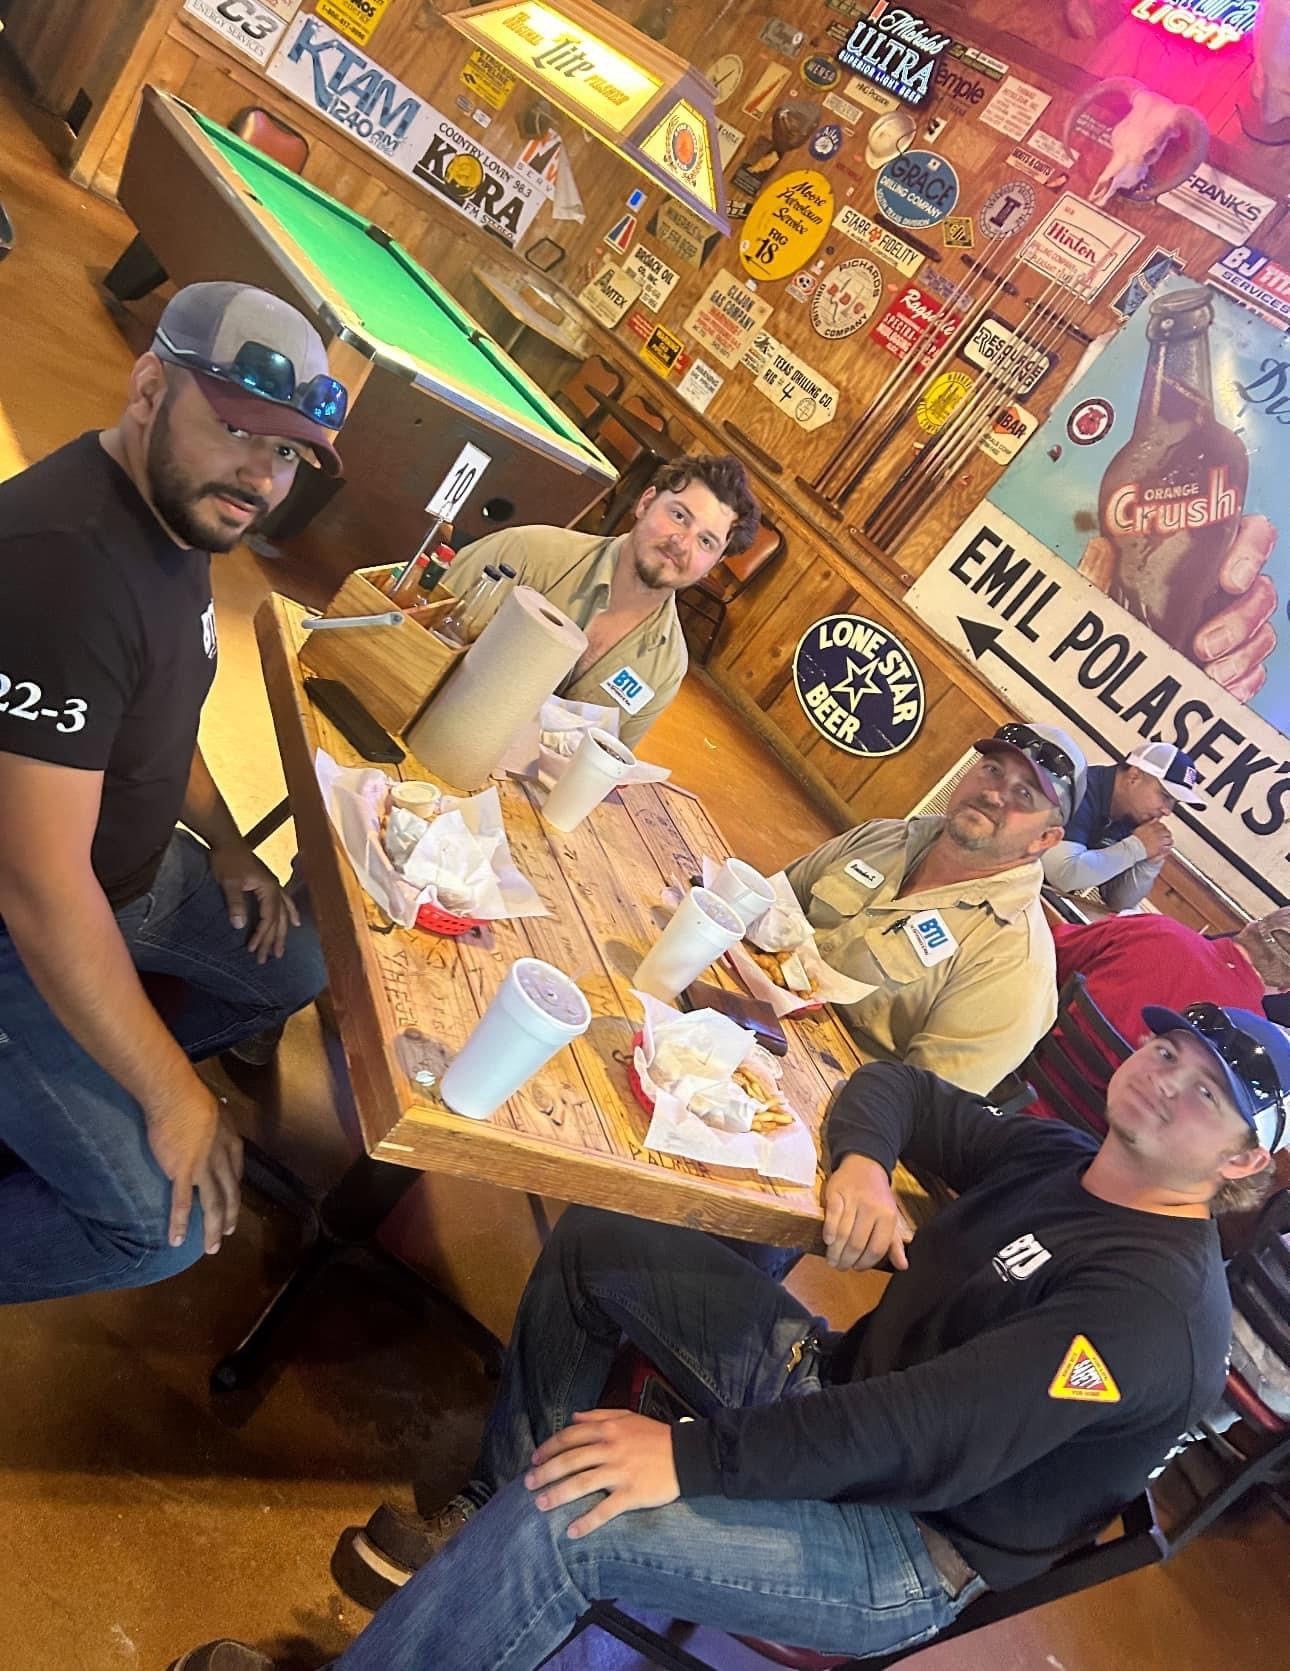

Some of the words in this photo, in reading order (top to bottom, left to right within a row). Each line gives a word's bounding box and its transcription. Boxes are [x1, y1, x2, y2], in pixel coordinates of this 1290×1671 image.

[226, 22, 267, 58] SERVICES
[878, 9, 951, 55] Michelob
[1131, 0, 1242, 50] LIGHT
[530, 32, 596, 78] Lite
[846, 21, 935, 96] ULTRA
[288, 18, 421, 139] KTAM
[838, 49, 876, 80] SUPERIOR
[875, 69, 901, 93] LIGHT
[898, 83, 923, 105] BEER
[327, 96, 375, 139] 1240
[439, 122, 484, 160] COUNTRY
[462, 201, 481, 221] FM
[777, 188, 824, 225] Petroleum
[788, 181, 828, 208] Moore
[879, 175, 907, 197] DRILLING
[907, 191, 944, 218] COMPANY
[754, 237, 780, 265] 18
[768, 227, 789, 246] RIG
[841, 210, 869, 235] STARR
[879, 233, 918, 266] FIDELITY
[1046, 221, 1096, 264] Hinton
[634, 248, 663, 274] BROACH
[660, 264, 675, 286] OIL
[838, 258, 882, 298] RICHARDS
[1222, 246, 1268, 278] BJ
[709, 289, 724, 308] GAS
[722, 299, 757, 332] COMPANY
[811, 283, 827, 328] DRILLING
[1220, 270, 1290, 317] SERVICES
[823, 312, 868, 338] COMPANY
[762, 368, 777, 387] RIG
[773, 353, 795, 376] TEXAS
[792, 367, 823, 399] DRILLING
[444, 461, 478, 505] 10
[1105, 464, 1242, 535] Crush
[1143, 482, 1200, 501] ORANGE
[612, 668, 643, 700] BTU
[819, 620, 887, 660] LONE
[877, 649, 918, 726] STAR
[949, 525, 1061, 643] EMIL
[1048, 610, 1290, 836] POLASEK'S
[804, 681, 861, 744] BEER
[917, 917, 949, 949] BTU
